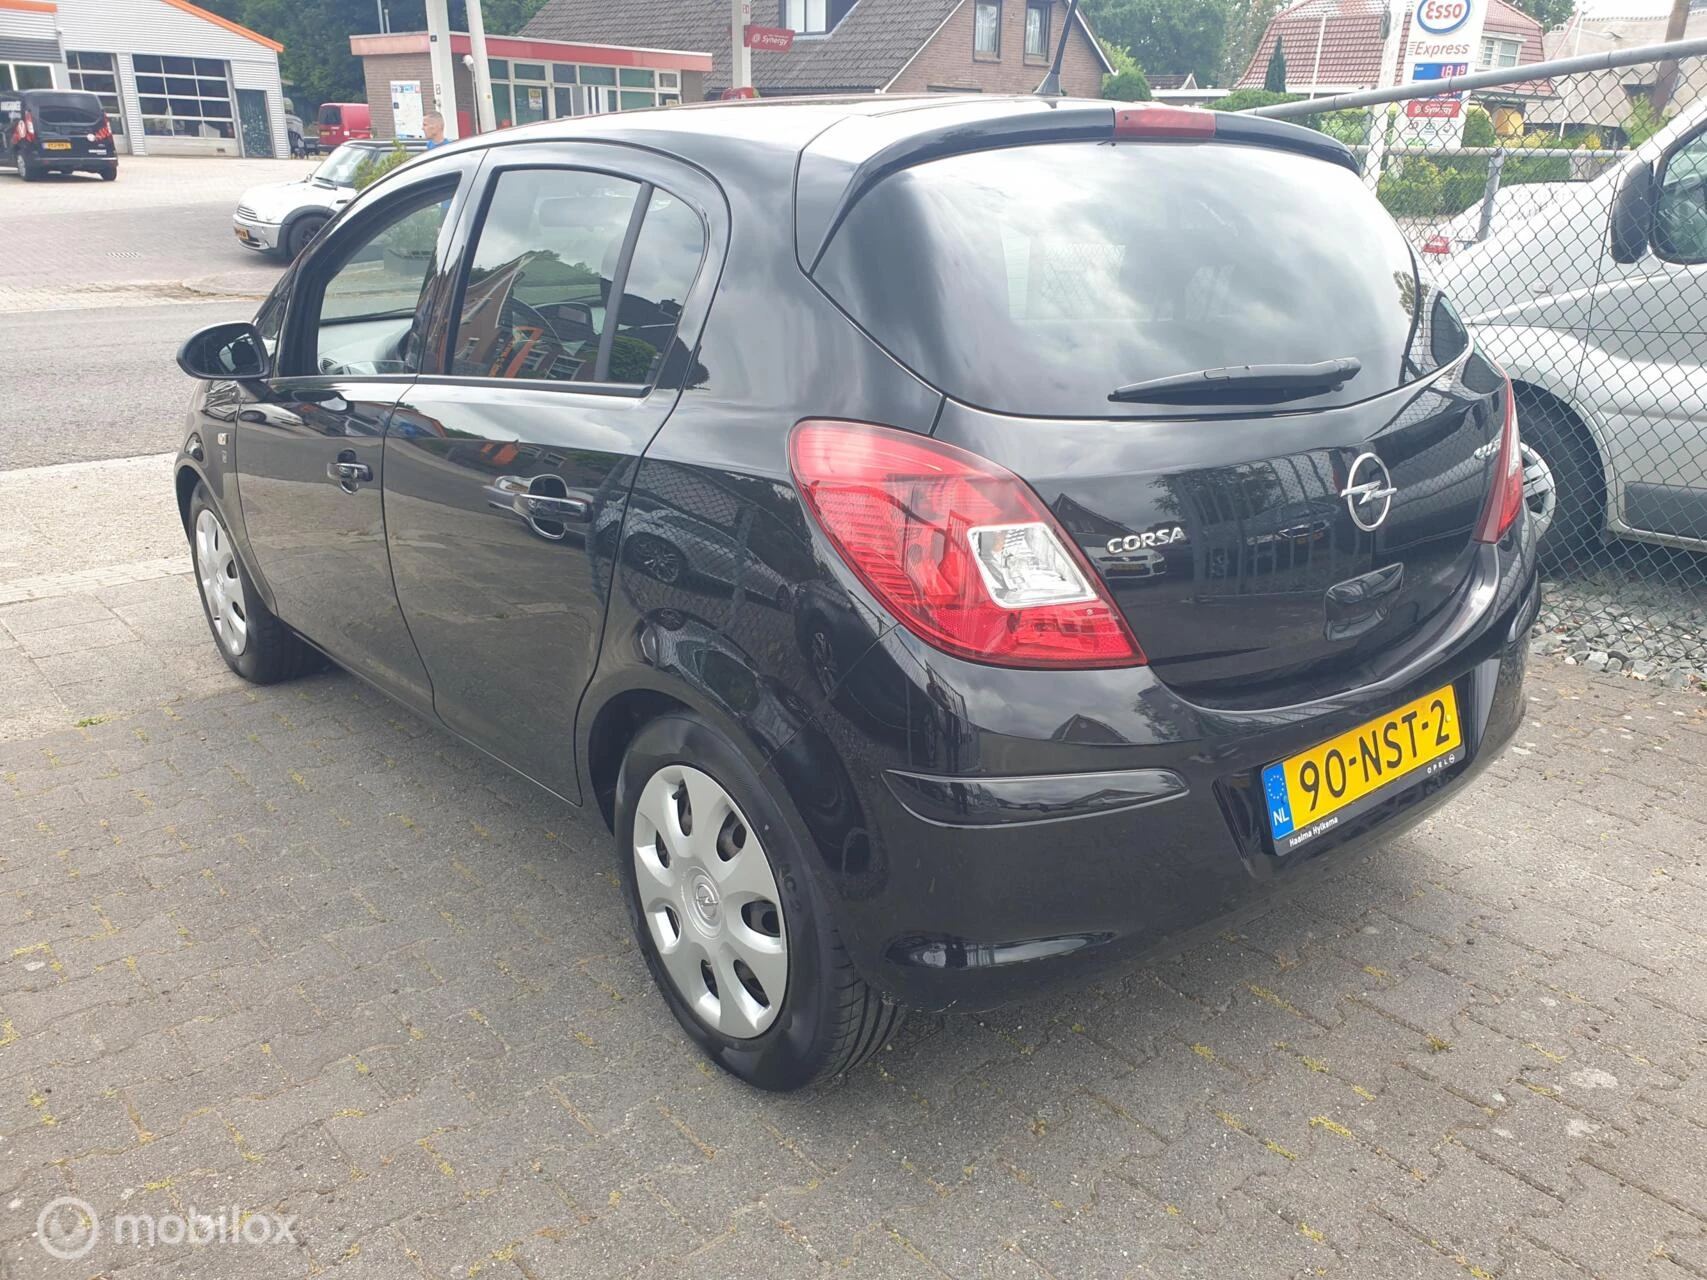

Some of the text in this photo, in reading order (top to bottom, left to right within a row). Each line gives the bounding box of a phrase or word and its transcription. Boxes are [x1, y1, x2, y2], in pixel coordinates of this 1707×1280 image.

[1426, 1, 1463, 20] Esso
[1414, 41, 1470, 58] Express
[1106, 526, 1187, 554] CORSA
[1299, 699, 1450, 812] 90-NST-2
[1273, 810, 1289, 826] NL
